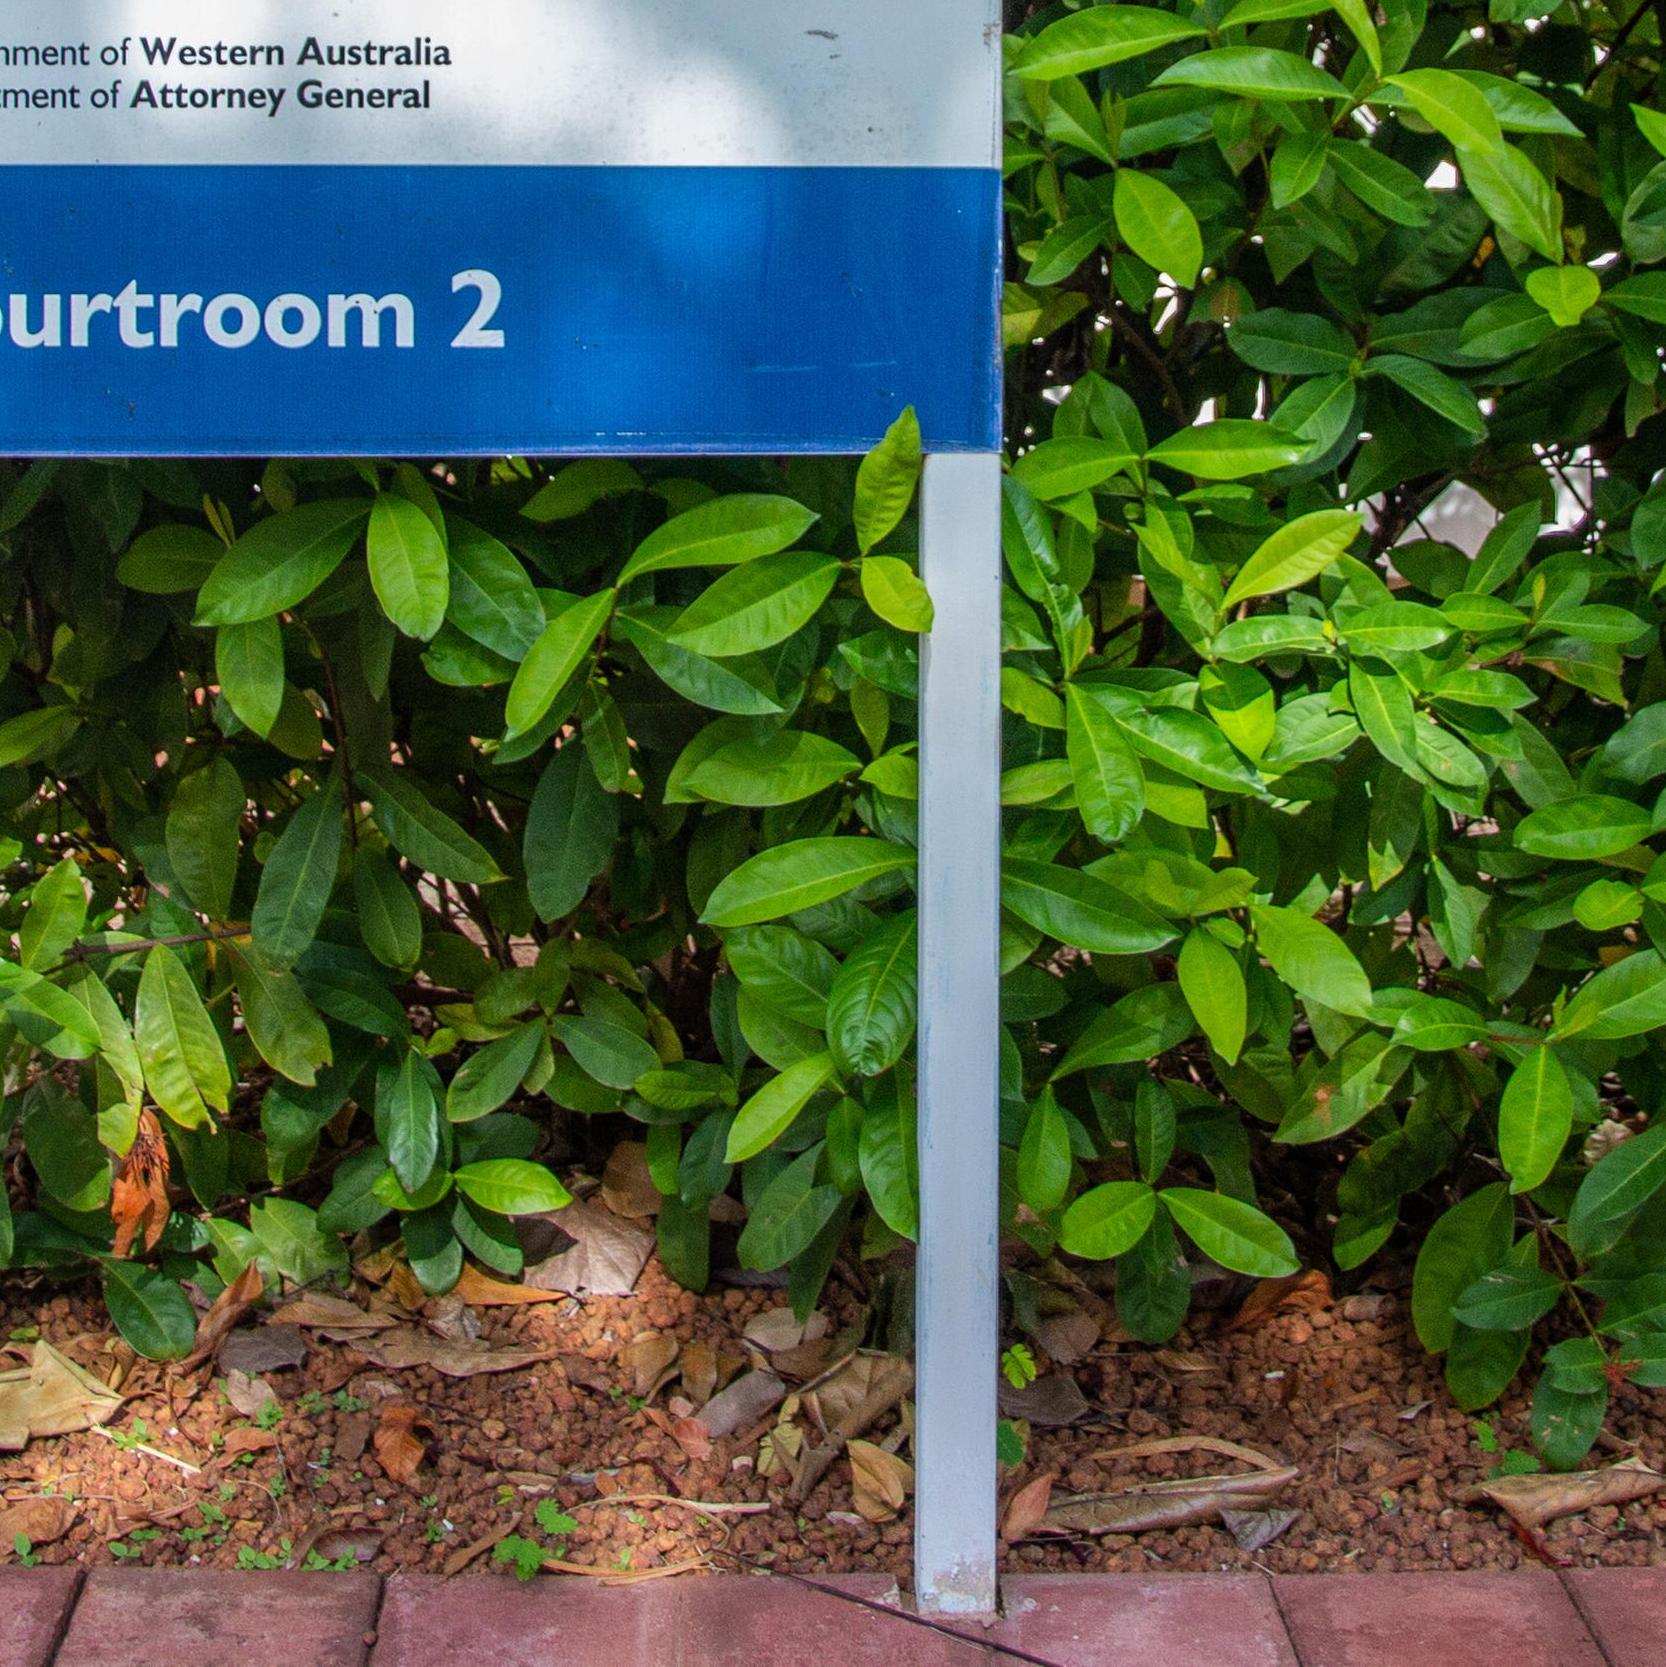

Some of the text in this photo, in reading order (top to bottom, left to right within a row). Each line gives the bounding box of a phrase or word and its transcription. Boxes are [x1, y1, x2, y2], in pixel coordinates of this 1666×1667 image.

[100, 36, 132, 66] of
[140, 37, 285, 66] Western
[296, 36, 452, 66] Australia
[90, 79, 122, 109] of
[129, 80, 286, 118] Attorney
[296, 79, 430, 109] General
[450, 269, 505, 348] 2
